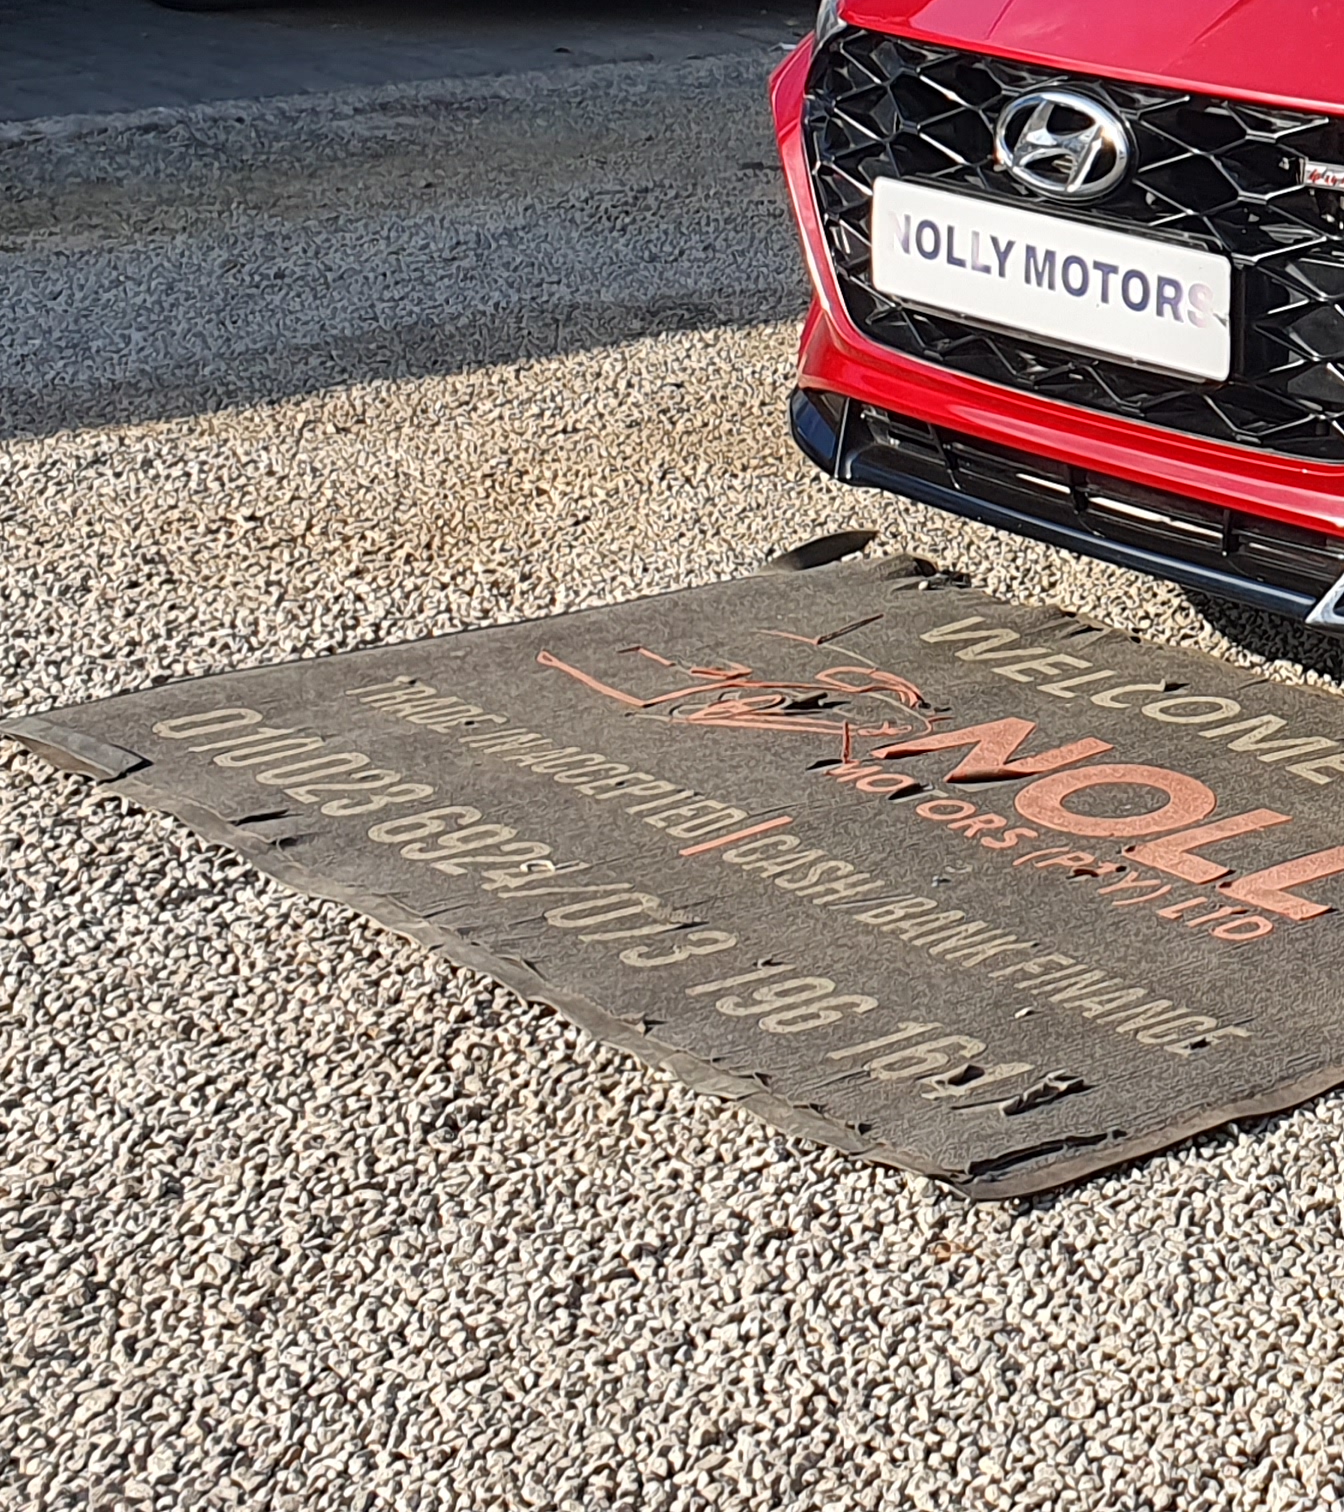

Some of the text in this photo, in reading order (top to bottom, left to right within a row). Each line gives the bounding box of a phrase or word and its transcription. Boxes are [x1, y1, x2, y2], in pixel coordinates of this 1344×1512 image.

[1023, 243, 1216, 329] MOTORS
[684, 960, 881, 1035] 196
[988, 952, 1254, 1059] FINANCE
